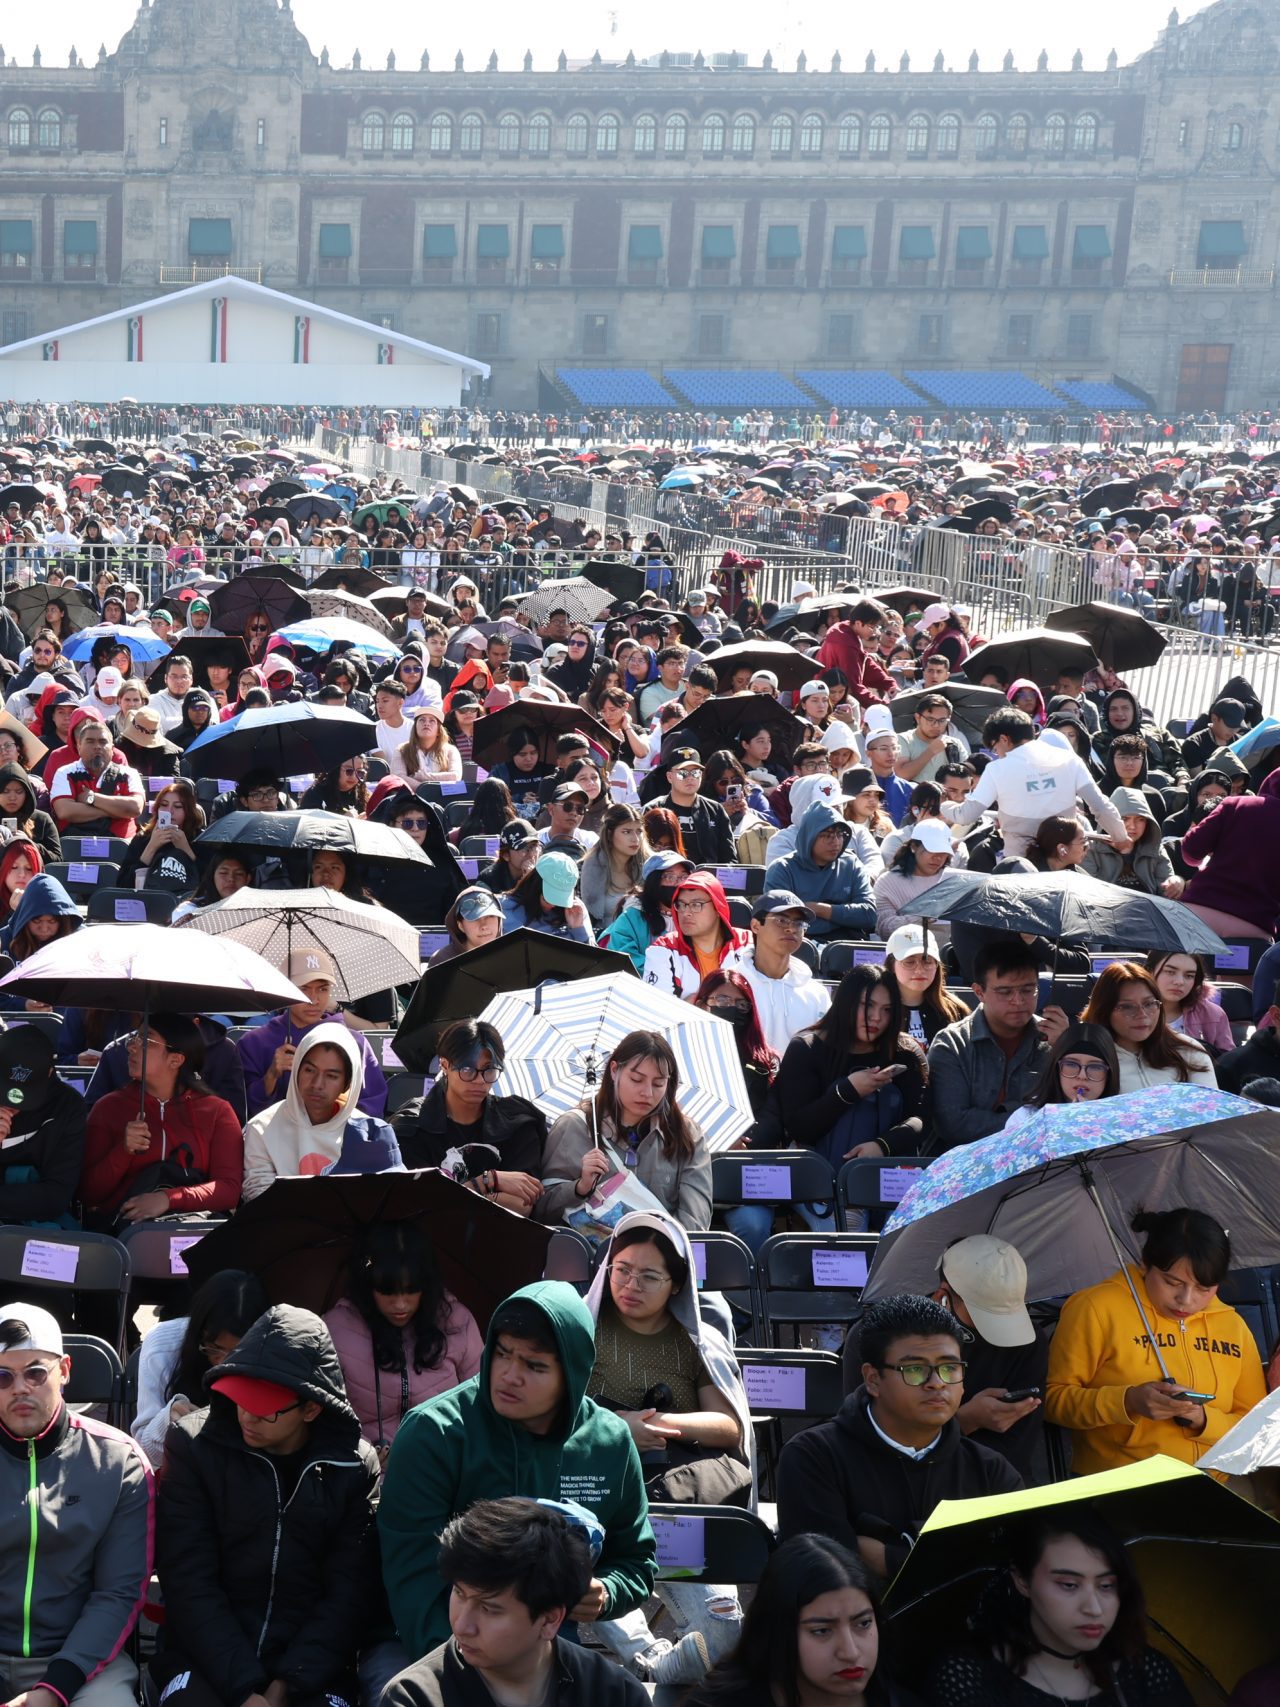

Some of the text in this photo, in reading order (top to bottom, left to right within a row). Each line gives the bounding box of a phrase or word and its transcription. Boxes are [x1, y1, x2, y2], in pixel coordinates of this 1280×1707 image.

[160, 856, 187, 876] VANS
[306, 955, 320, 969] NY
[1193, 1336, 1242, 1359] JEANS
